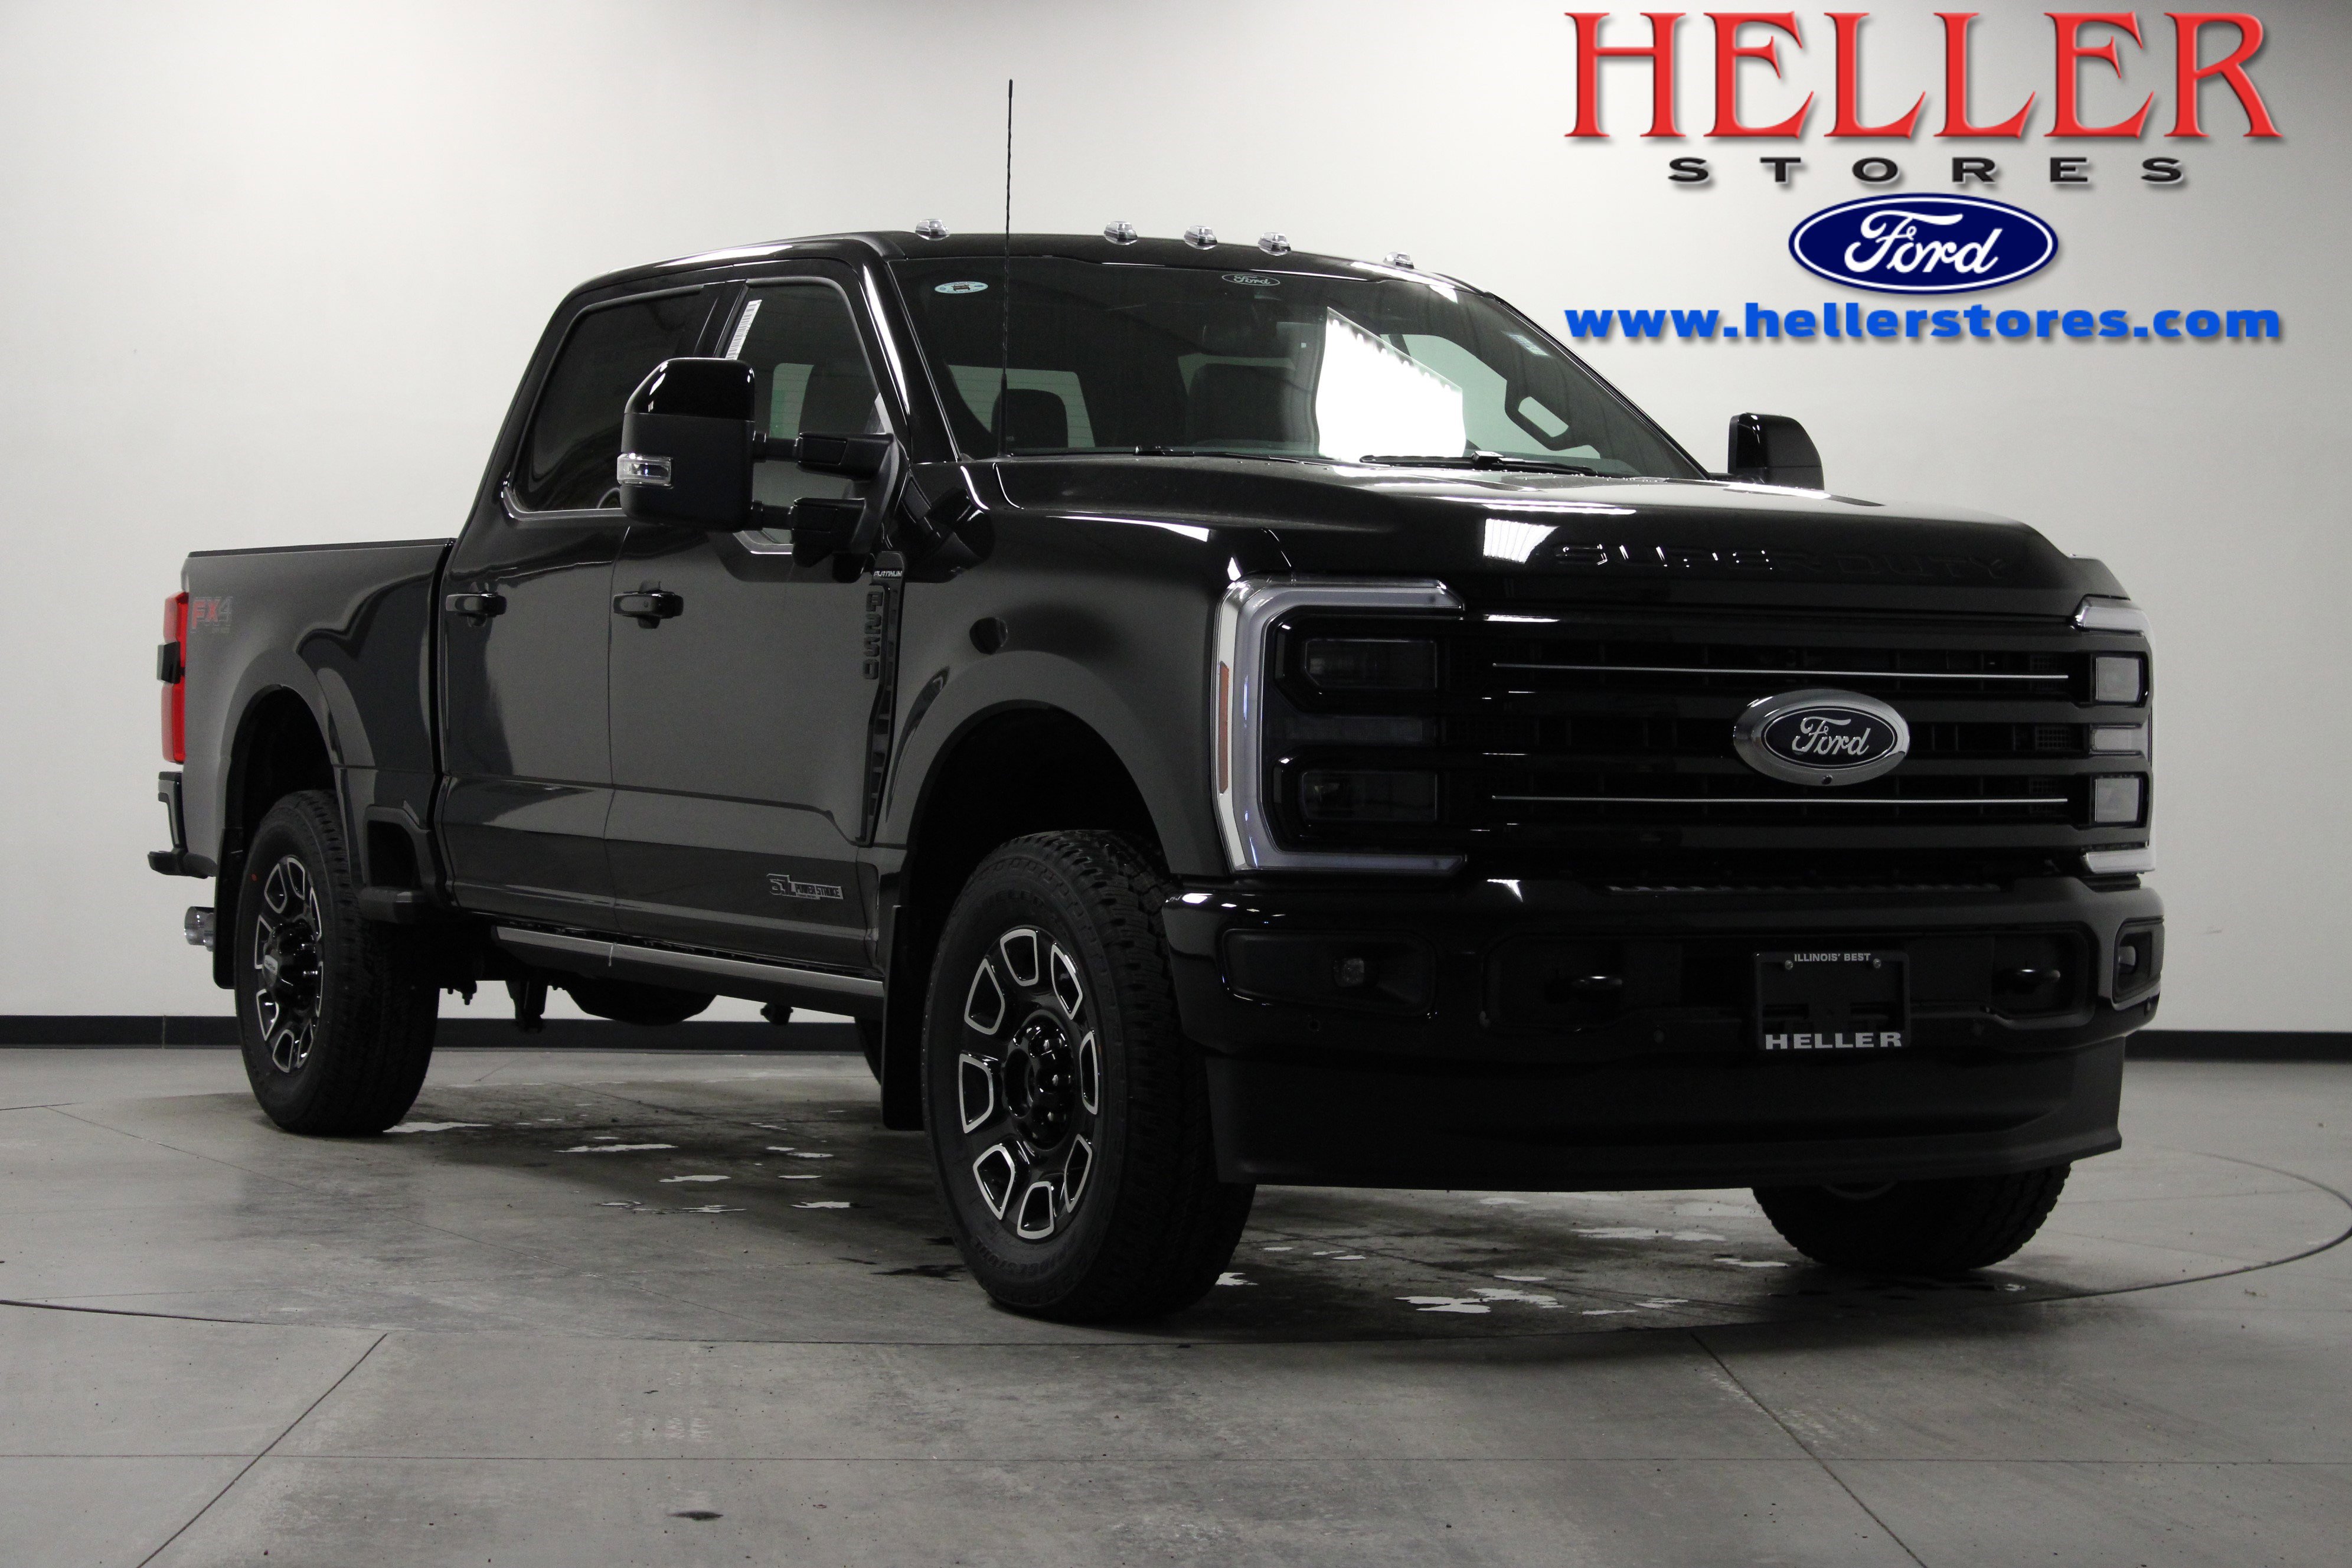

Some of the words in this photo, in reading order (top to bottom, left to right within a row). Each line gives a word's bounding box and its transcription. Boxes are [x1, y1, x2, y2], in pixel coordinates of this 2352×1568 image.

[1233, 274, 1270, 285] Ford
[1555, 543, 1822, 573] SUPER
[191, 596, 233, 632] FX4
[1792, 716, 1871, 756] Ford
[795, 883, 816, 895] POWER
[816, 886, 841, 897] STROKE
[1794, 953, 1840, 962] ILLINOIS'
[1844, 952, 1871, 961] BEST
[1765, 1031, 1902, 1050] HELLER
